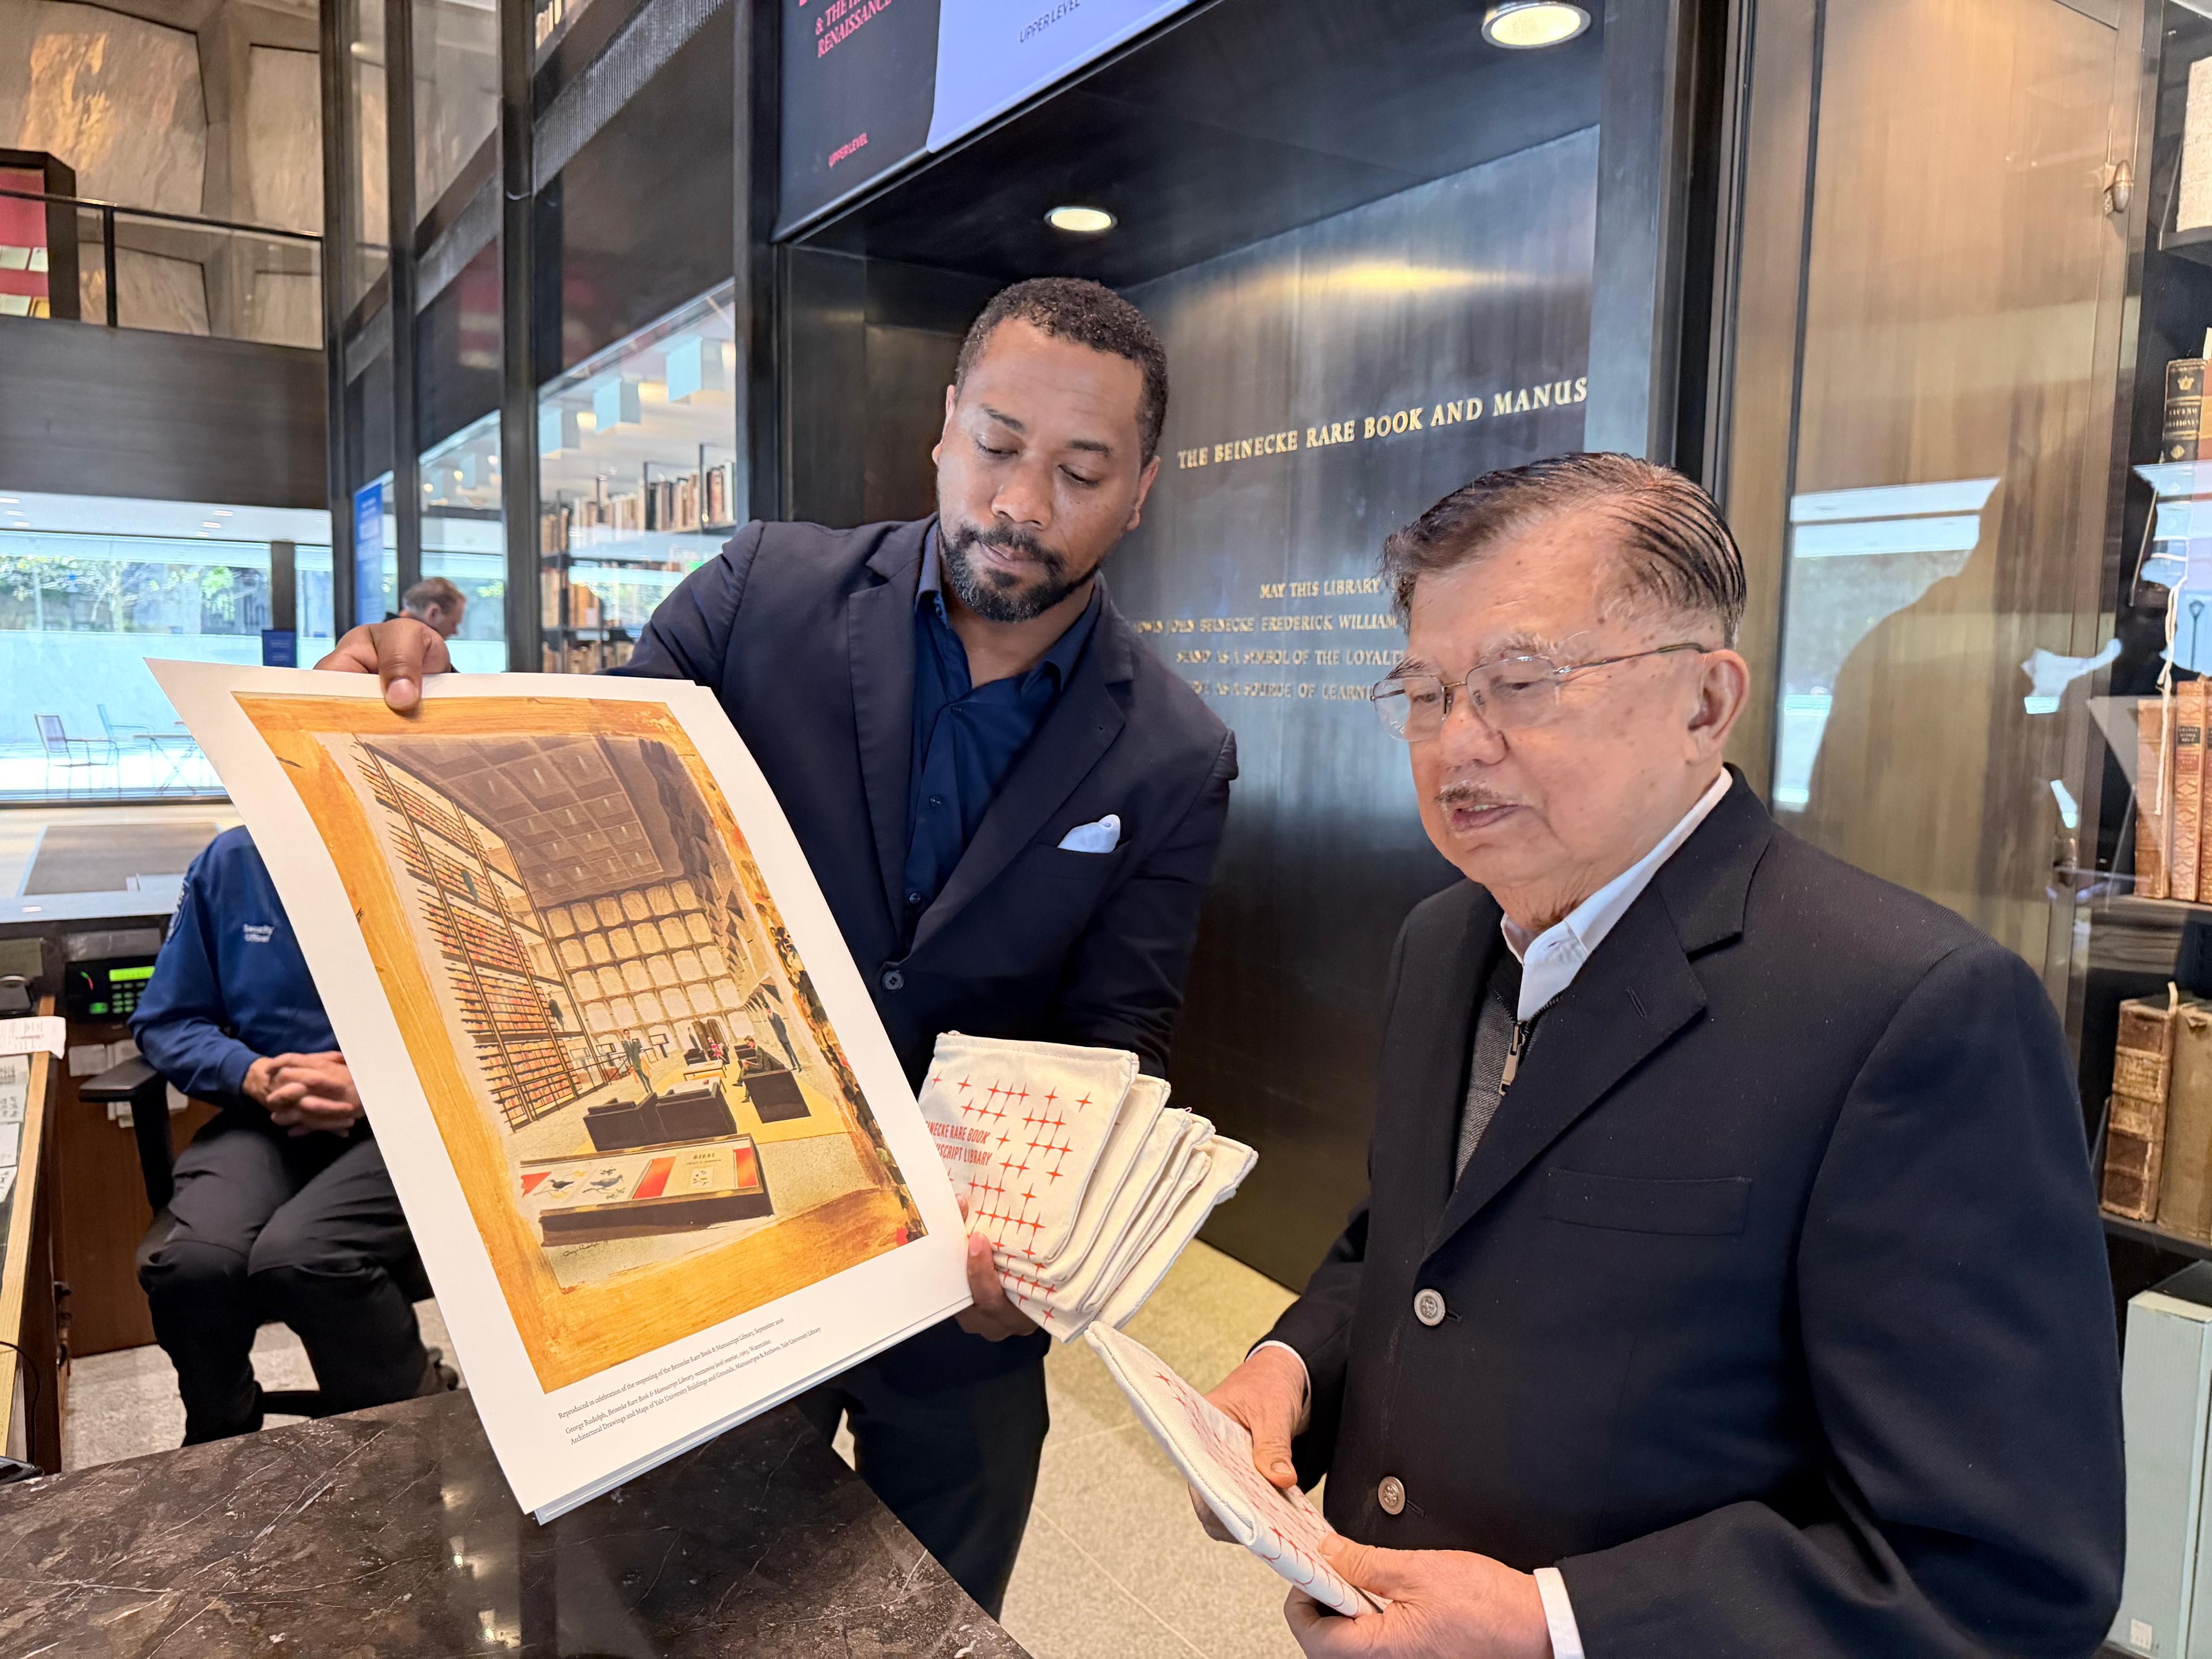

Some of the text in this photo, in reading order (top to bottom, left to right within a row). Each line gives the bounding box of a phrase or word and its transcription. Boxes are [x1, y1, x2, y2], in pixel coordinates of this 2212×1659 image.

[825, 0, 847, 27] THE
[1019, 14, 1050, 43] UPPER
[849, 132, 868, 154] LEVEL
[1177, 376, 1588, 469] THE BEINECKE RARE BOOK AND MANUS
[1260, 577, 1381, 599] MAY THIS LIBRARY
[1200, 617, 1255, 633] BEINECKE
[1261, 615, 1334, 632] FREDERICK
[1339, 613, 1398, 630] WILLIAM
[1292, 649, 1310, 665] OF
[1314, 649, 1340, 665] THE
[1298, 682, 1317, 699] OF
[950, 1125, 967, 1141] RARE
[967, 1128, 991, 1144] BOOK
[963, 1149, 993, 1166] LIBRARY
[558, 1402, 589, 1419] Reproduced
[595, 1388, 622, 1404] celebration
[565, 1422, 584, 1434] George
[584, 1412, 608, 1427] Rudolph,
[608, 1403, 627, 1415] Beinecke
[627, 1398, 638, 1407] Rare
[638, 1393, 650, 1402] Book
[571, 1426, 602, 1445] Architectural
[602, 1415, 626, 1429] Drawings
[626, 1411, 636, 1419] and
[635, 1406, 649, 1415] Maps
[654, 1398, 664, 1406] Yale
